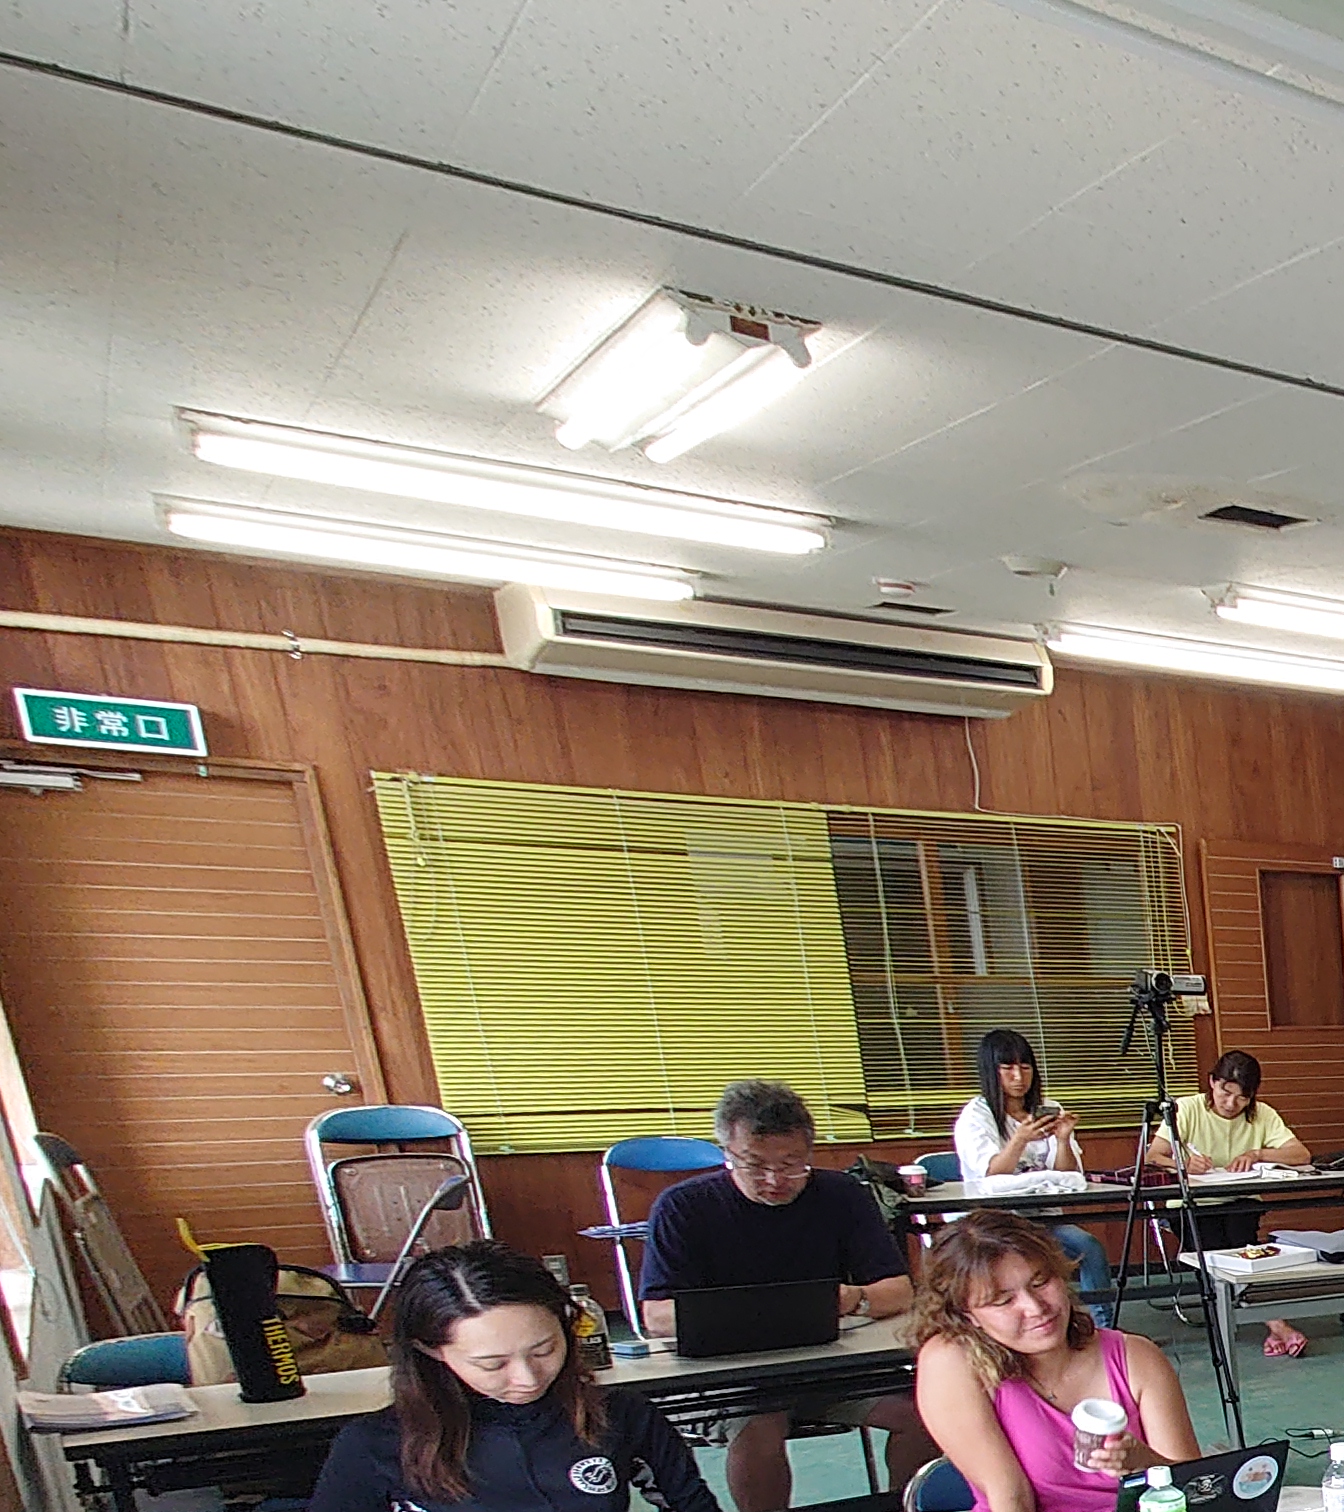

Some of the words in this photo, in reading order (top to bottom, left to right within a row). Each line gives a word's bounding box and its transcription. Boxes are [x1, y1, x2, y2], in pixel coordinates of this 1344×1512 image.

[51, 705, 171, 742] 非常口
[261, 1316, 301, 1385] THERMOS
